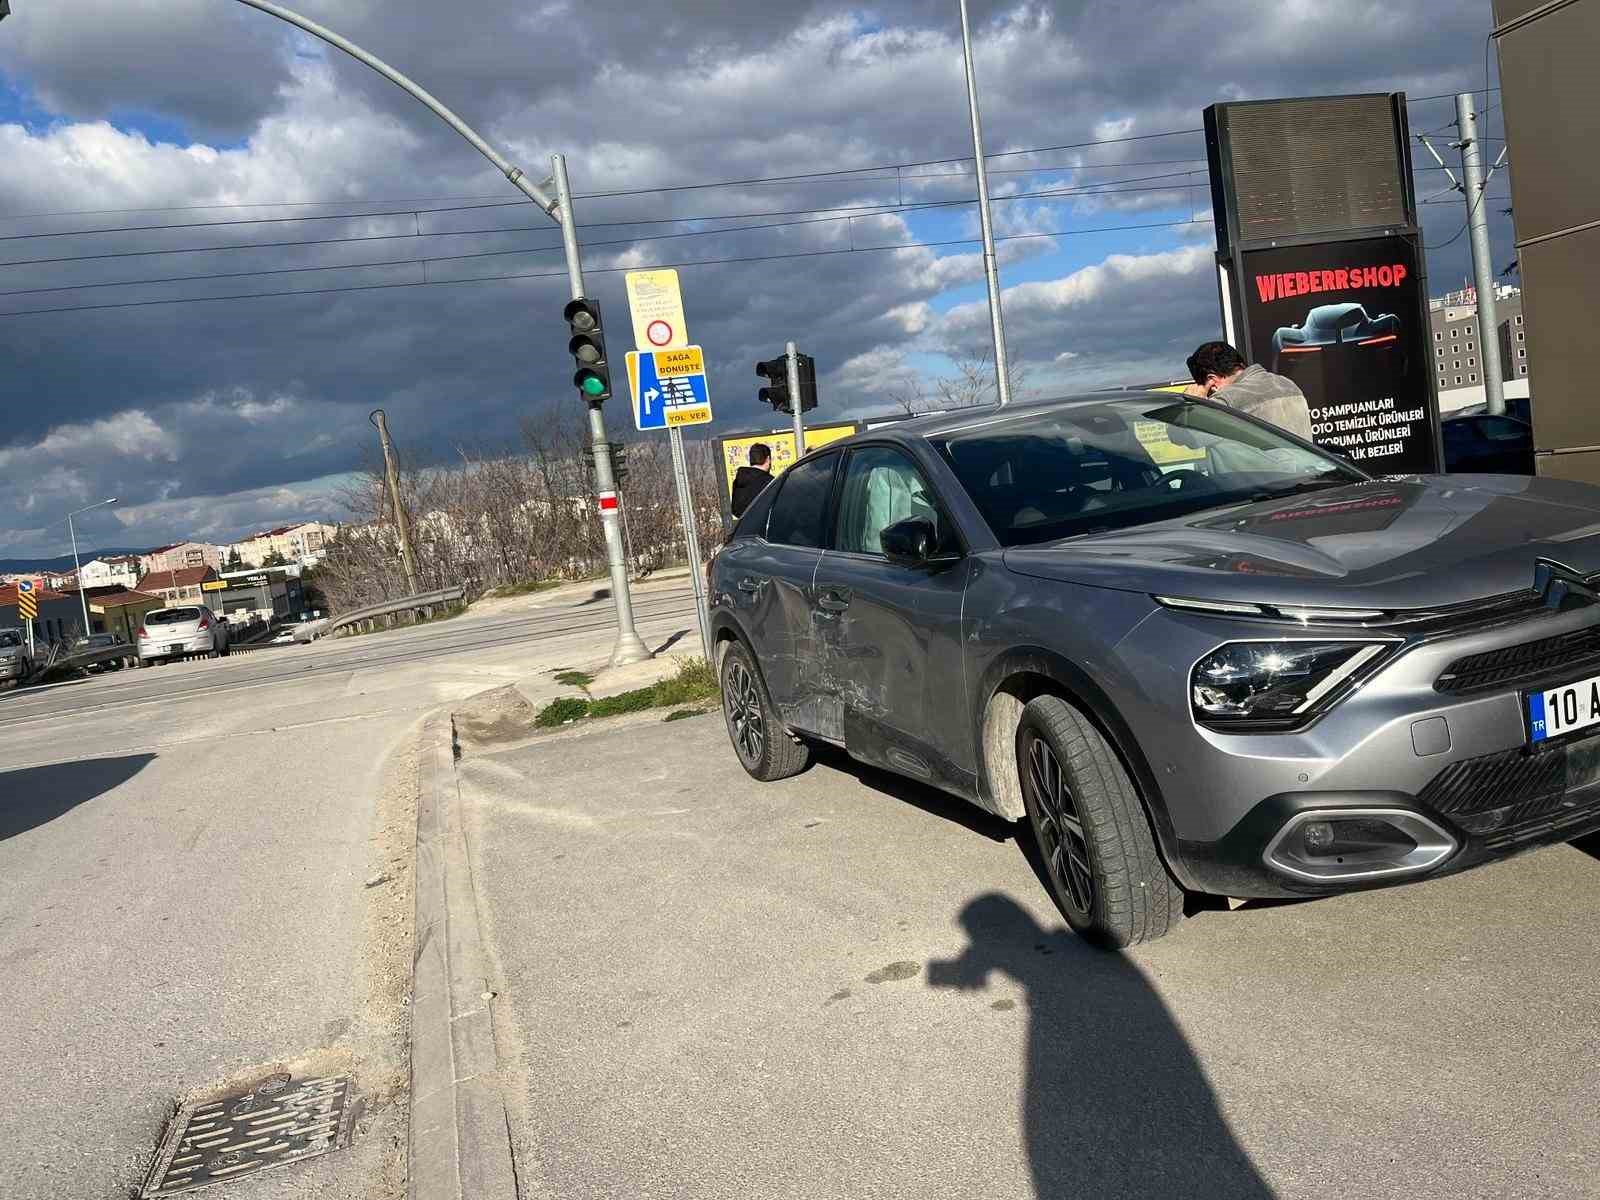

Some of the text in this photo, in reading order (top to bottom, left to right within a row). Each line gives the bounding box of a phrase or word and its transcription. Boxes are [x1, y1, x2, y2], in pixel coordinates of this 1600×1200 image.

[1322, 397, 1394, 420] ŞAMPUANLARI
[1311, 406, 1424, 435] OTO TEMİZLİK ÜRÜNLERİ
[1365, 424, 1411, 442] ÜRÜNLERİ
[1368, 440, 1404, 458] BEZLERİ
[1532, 719, 1545, 732] TR
[1549, 688, 1578, 730] 10
